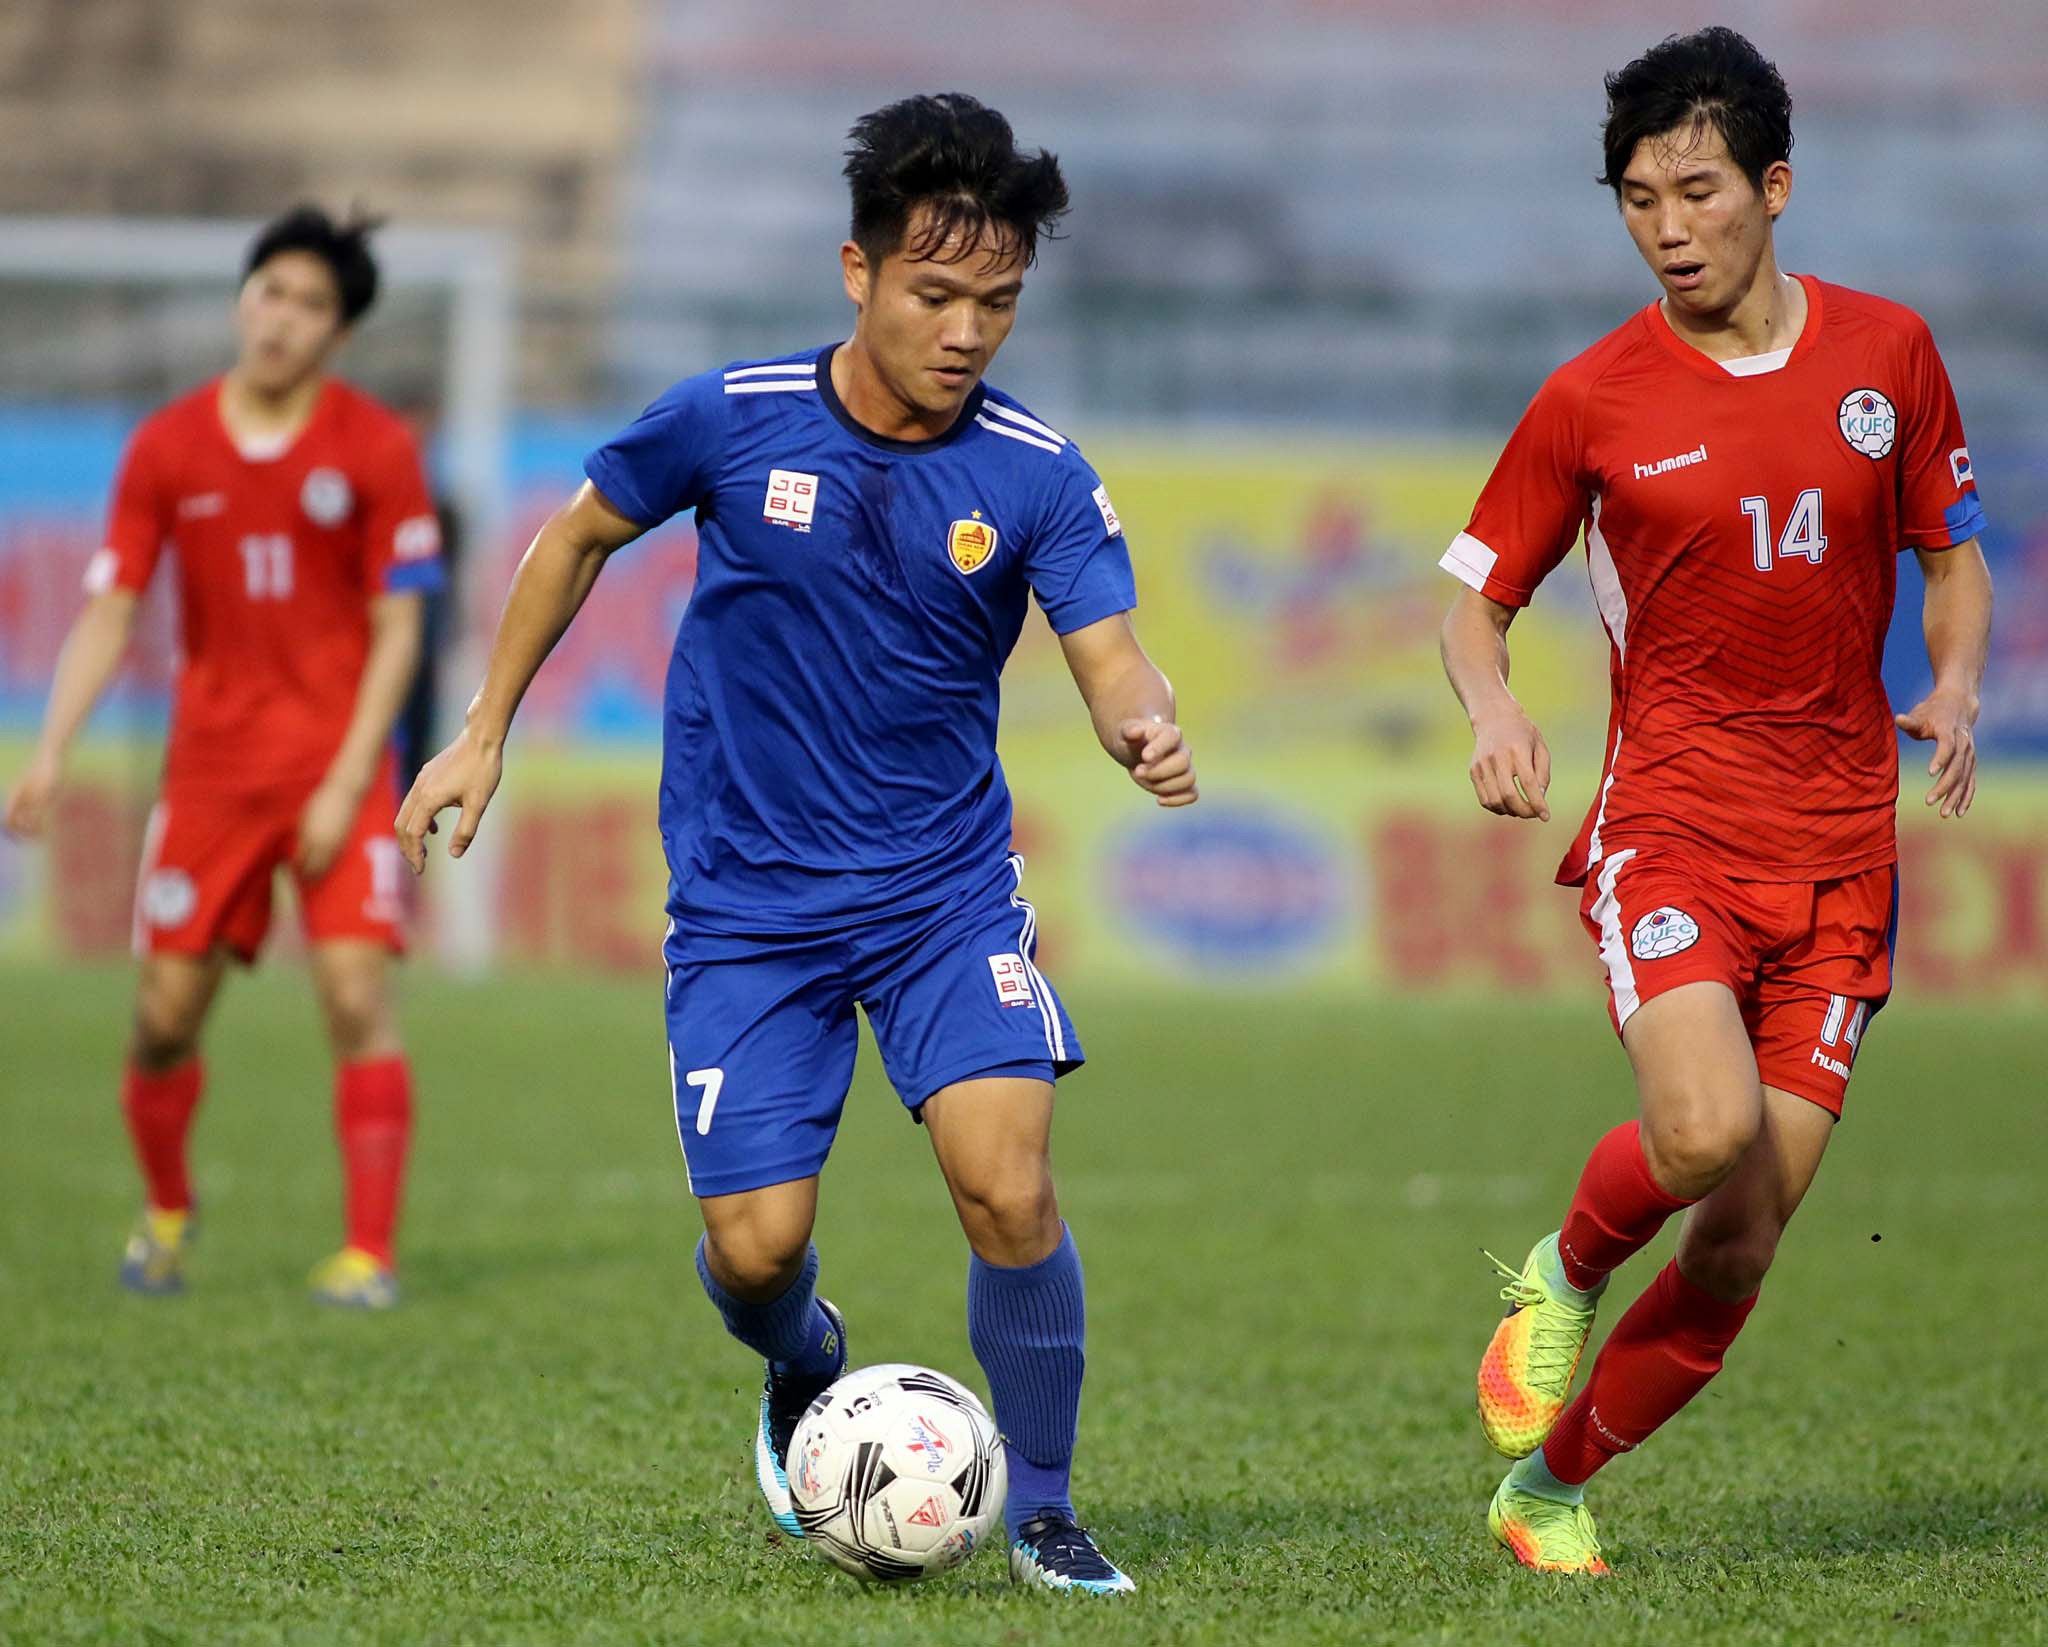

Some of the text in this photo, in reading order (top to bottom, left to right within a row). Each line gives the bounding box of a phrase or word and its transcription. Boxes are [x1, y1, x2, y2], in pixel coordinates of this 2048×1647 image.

[1846, 416, 1893, 434] KUFC
[1633, 443, 1709, 480] hummel
[1739, 487, 1828, 572] 14
[237, 533, 295, 600] 11
[1638, 922, 1693, 951] KUFC
[686, 1067, 725, 1137] 7
